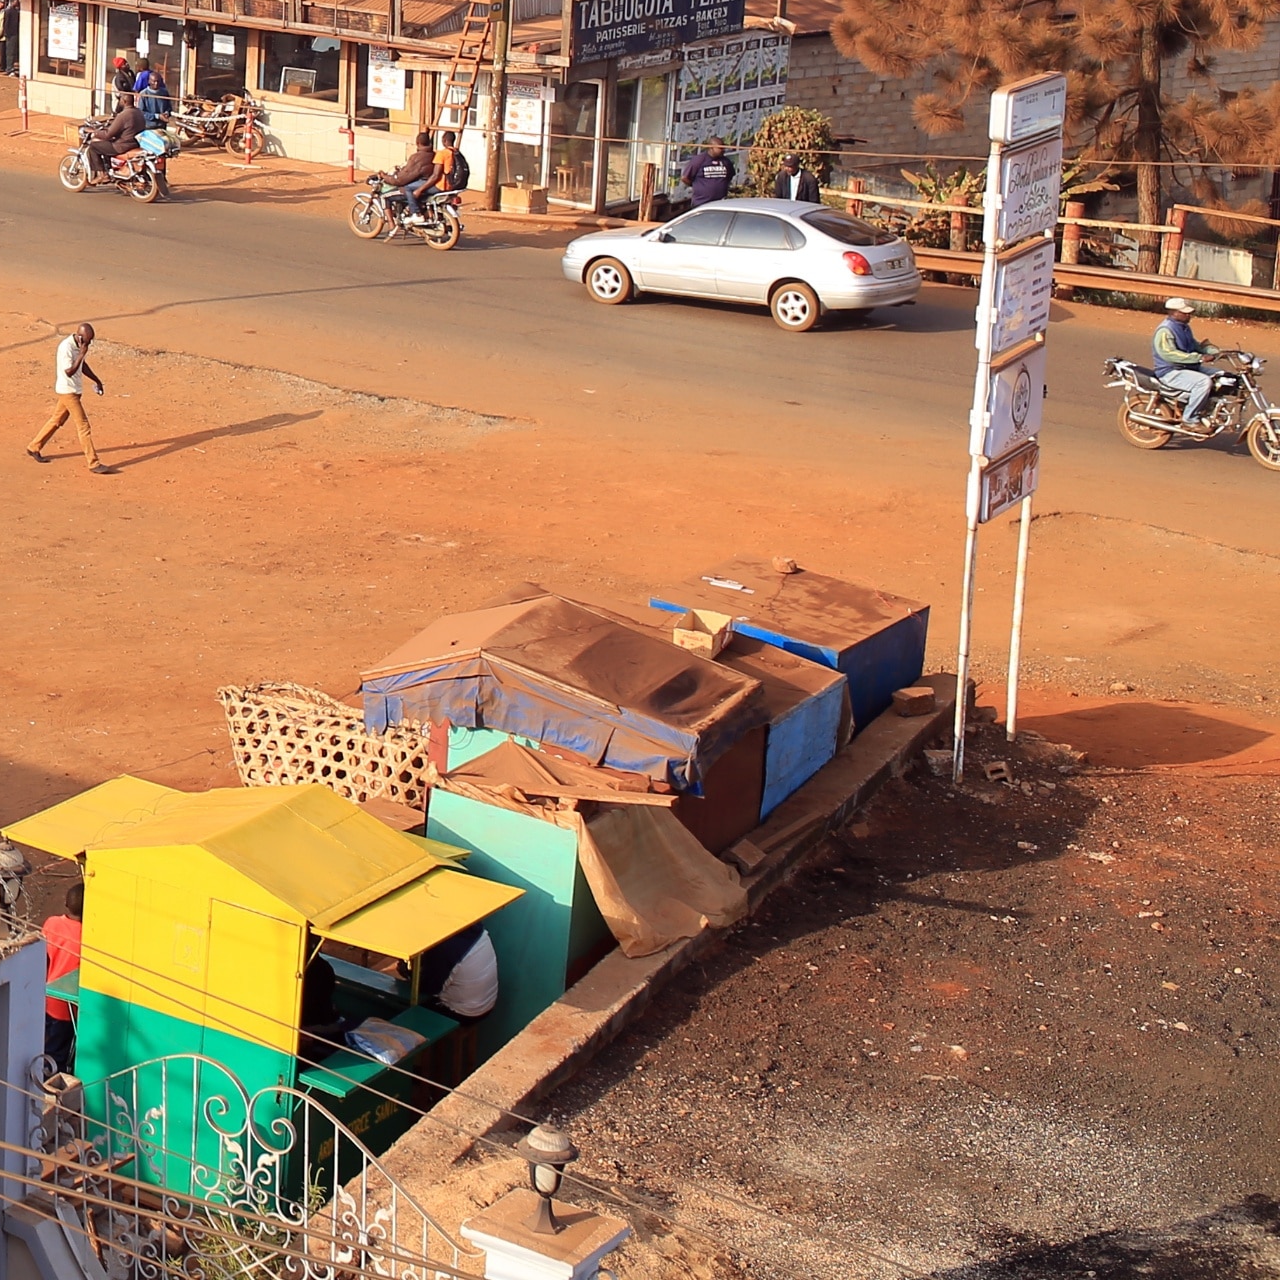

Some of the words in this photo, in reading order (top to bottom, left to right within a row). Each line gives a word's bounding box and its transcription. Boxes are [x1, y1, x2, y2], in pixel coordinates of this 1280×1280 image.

[596, 22, 646, 43] PATISSERIE
[655, 14, 687, 31] PIZZAS
[696, 7, 728, 22] BAKERY
[512, 86, 535, 94] PLAZA
